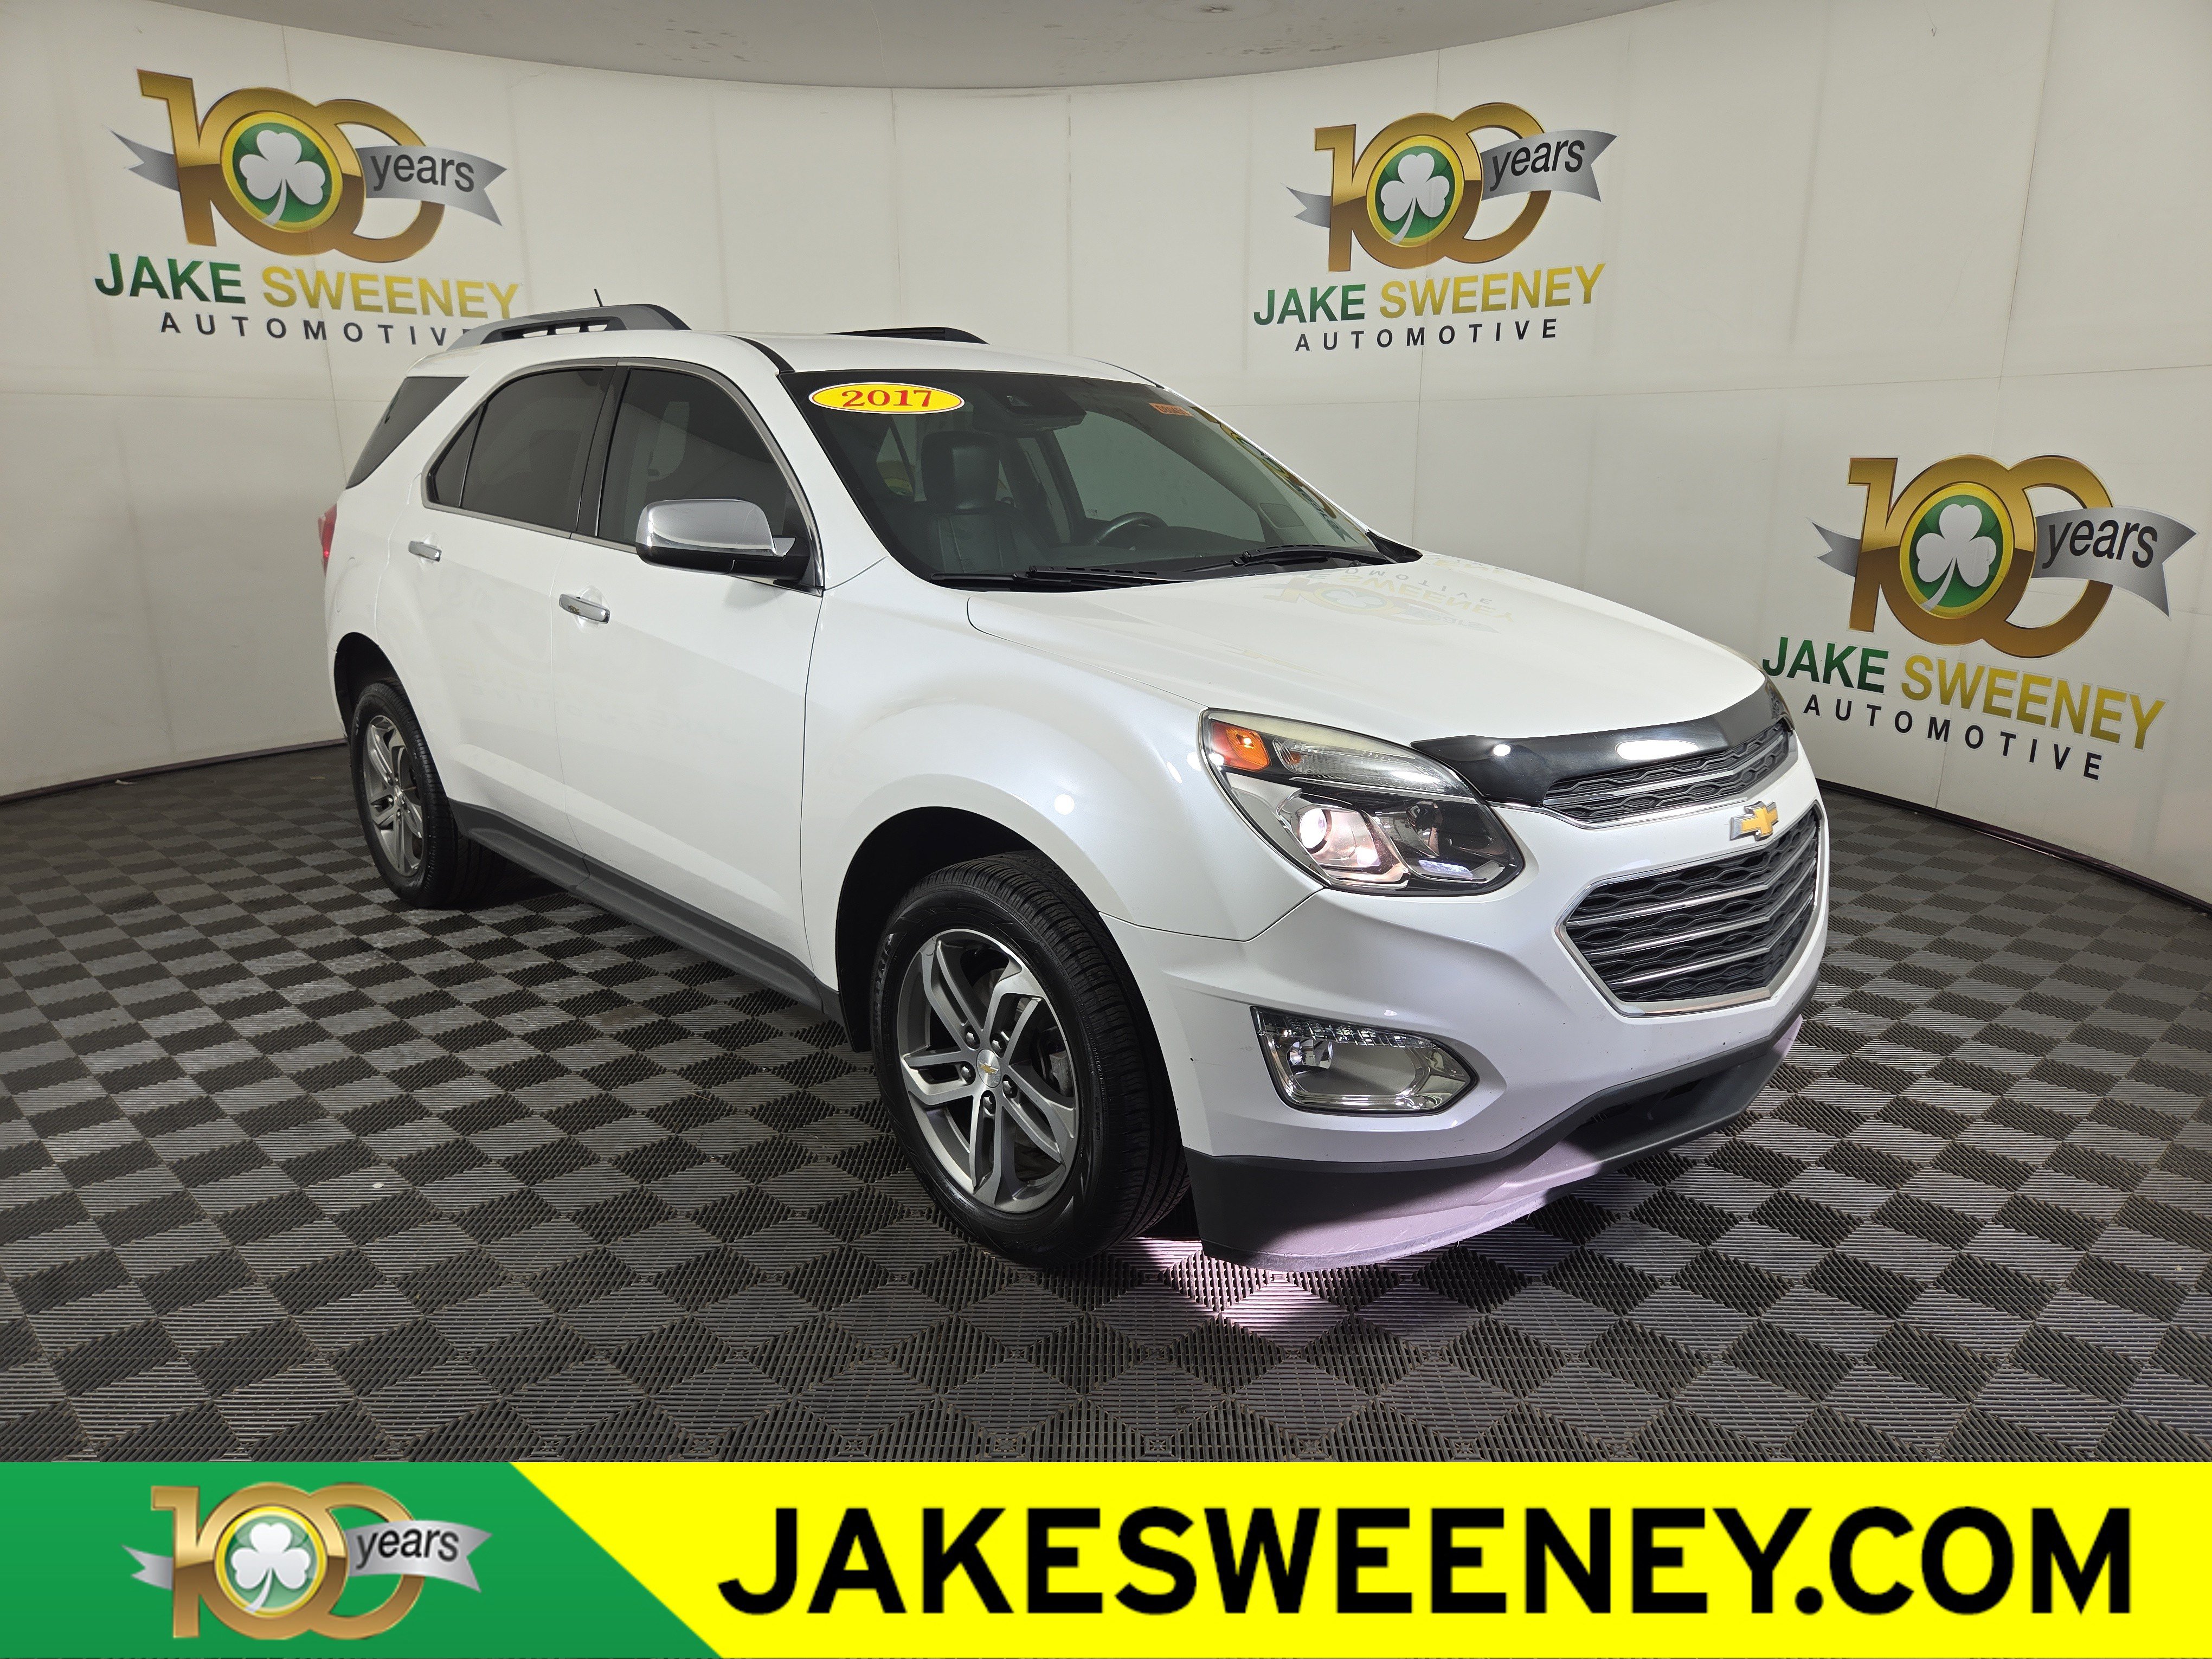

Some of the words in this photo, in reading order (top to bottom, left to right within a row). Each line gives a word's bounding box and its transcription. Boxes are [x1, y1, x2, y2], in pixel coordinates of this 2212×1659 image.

[136, 68, 446, 263] 100
[370, 153, 475, 193] years
[1314, 102, 1552, 273] 100
[1489, 139, 1585, 192] years
[94, 253, 246, 305] JAKE
[261, 266, 519, 320] SWEENEY
[1253, 284, 1366, 325] JAKE
[1379, 263, 1606, 319] SWEENEY
[160, 312, 473, 346] AUTOMOTIV
[1295, 318, 1557, 352] AUTOMOTIVE
[841, 390, 932, 407] 2017
[1848, 454, 2115, 658] 100
[2041, 519, 2158, 569] years
[1763, 636, 1889, 693] JAKE
[1901, 654, 2166, 750] SWEENEY
[1804, 694, 2102, 781] AUTOMOTIVE
